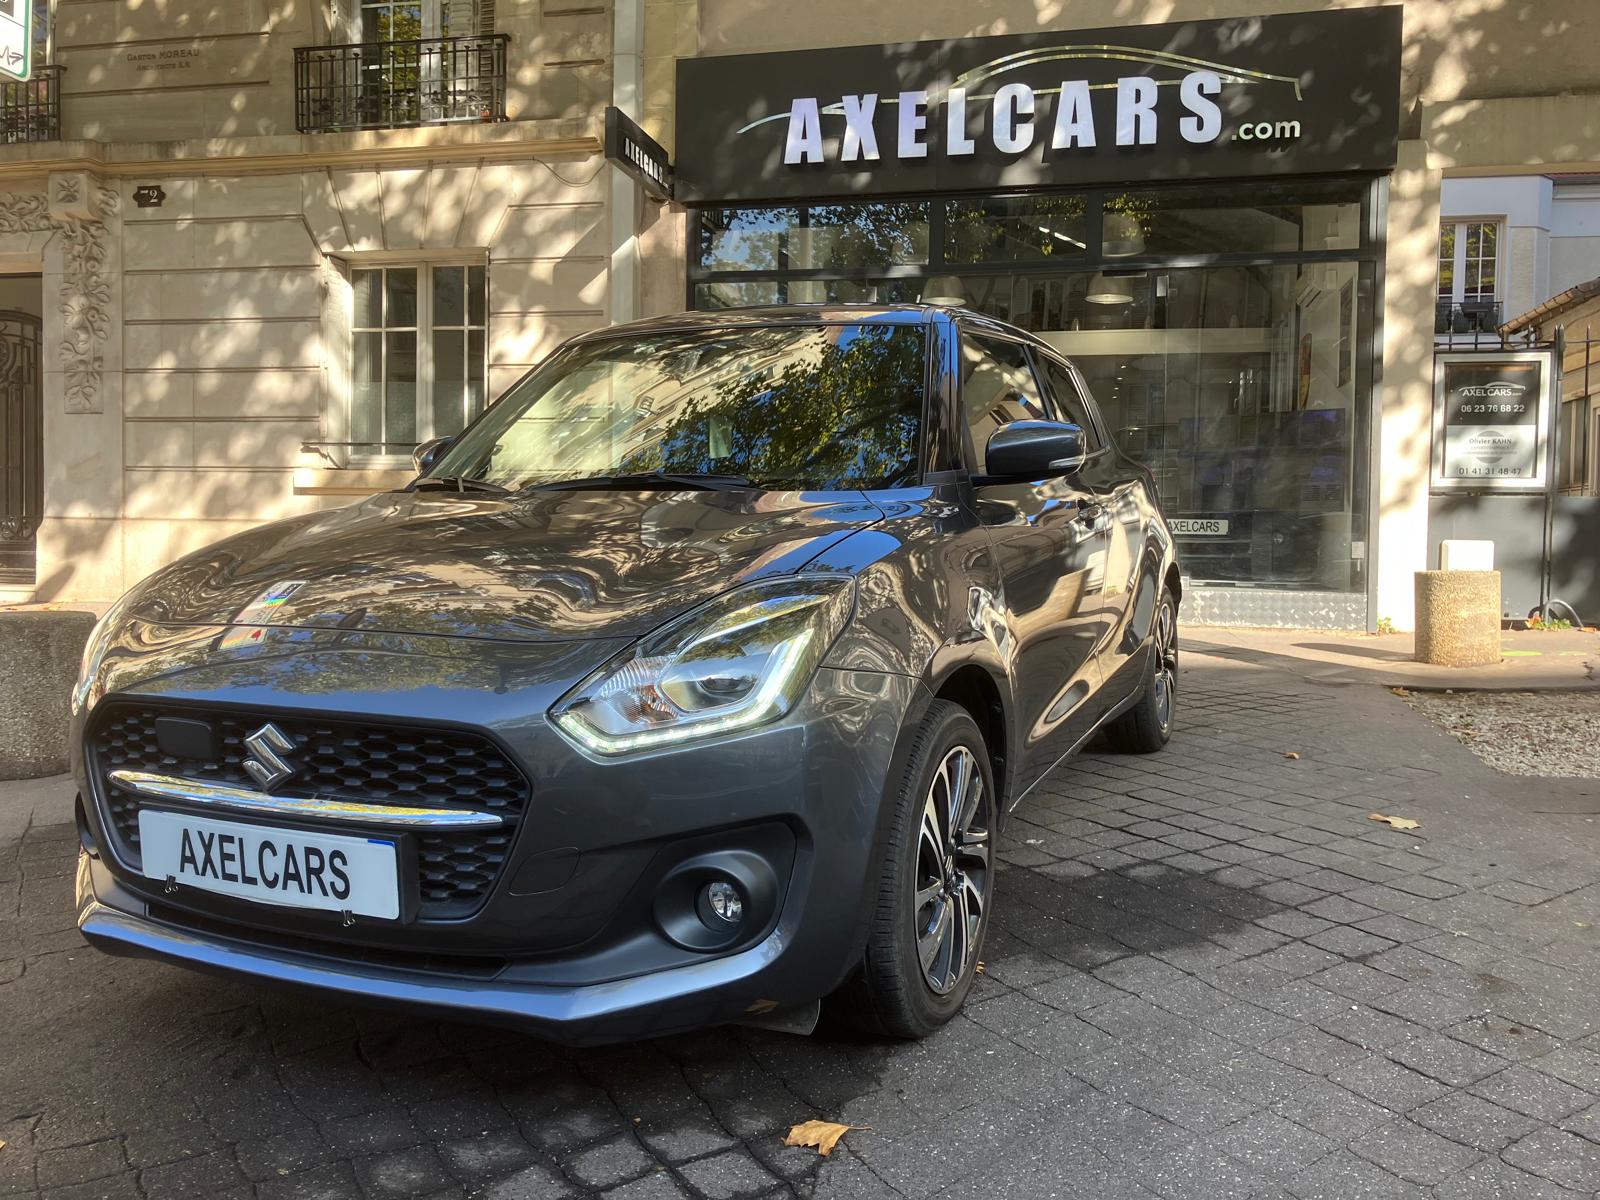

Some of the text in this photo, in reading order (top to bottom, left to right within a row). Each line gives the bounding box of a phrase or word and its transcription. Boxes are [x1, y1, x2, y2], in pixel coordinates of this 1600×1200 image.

[159, 49, 200, 60] MOREAU
[784, 71, 1301, 165] AXELCARS .com
[624, 137, 664, 184] AXELCARS
[1461, 404, 1472, 413] 06
[1474, 404, 1485, 413] 23
[1487, 404, 1498, 413] 76
[1513, 404, 1525, 413] 22
[1458, 467, 1469, 475] 01
[1471, 467, 1482, 475] 41
[1484, 467, 1495, 475] 31
[1167, 520, 1220, 533] AXELCARS
[180, 827, 351, 900] AXELCARS
